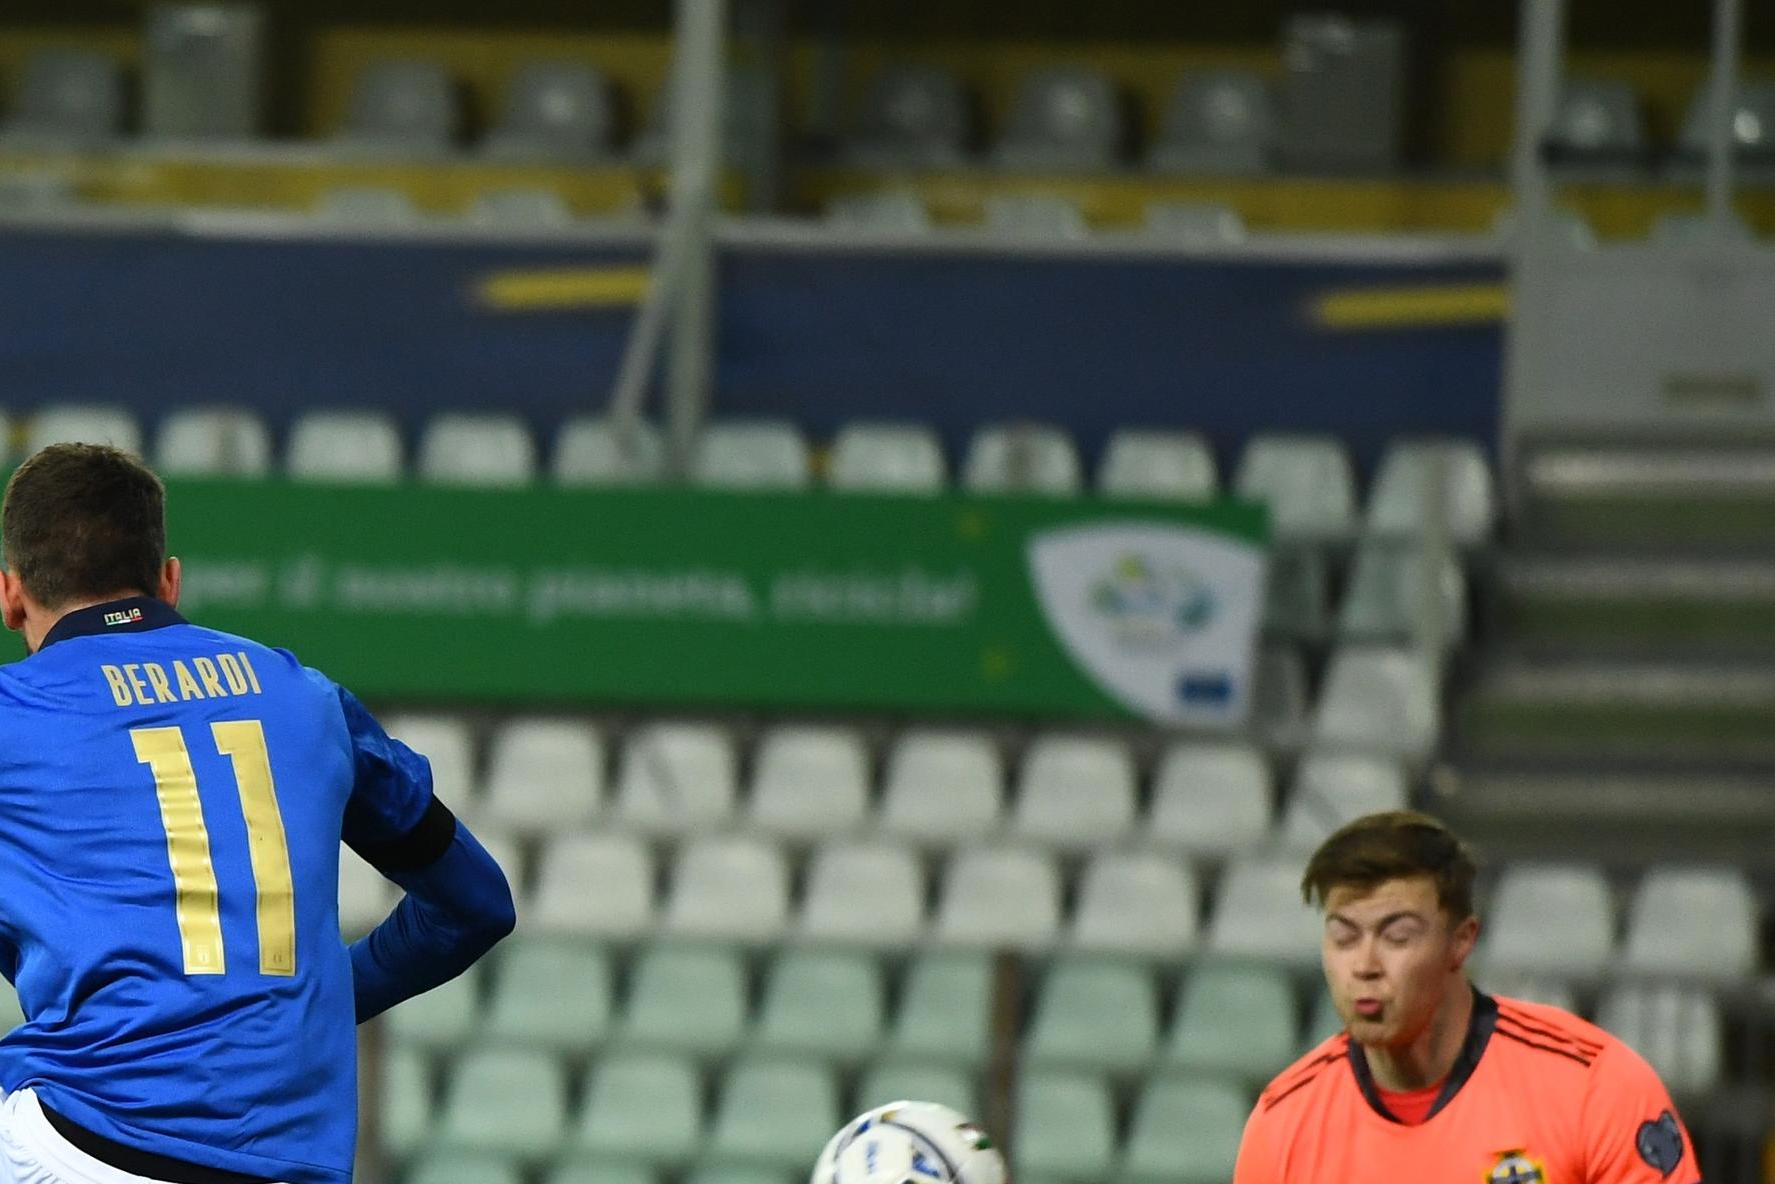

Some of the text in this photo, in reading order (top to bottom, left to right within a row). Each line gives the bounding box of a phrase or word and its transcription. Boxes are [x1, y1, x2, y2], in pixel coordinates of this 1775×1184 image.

[104, 607, 142, 623] ITALIA
[101, 651, 262, 706] BERARDI
[130, 719, 297, 976] 11
